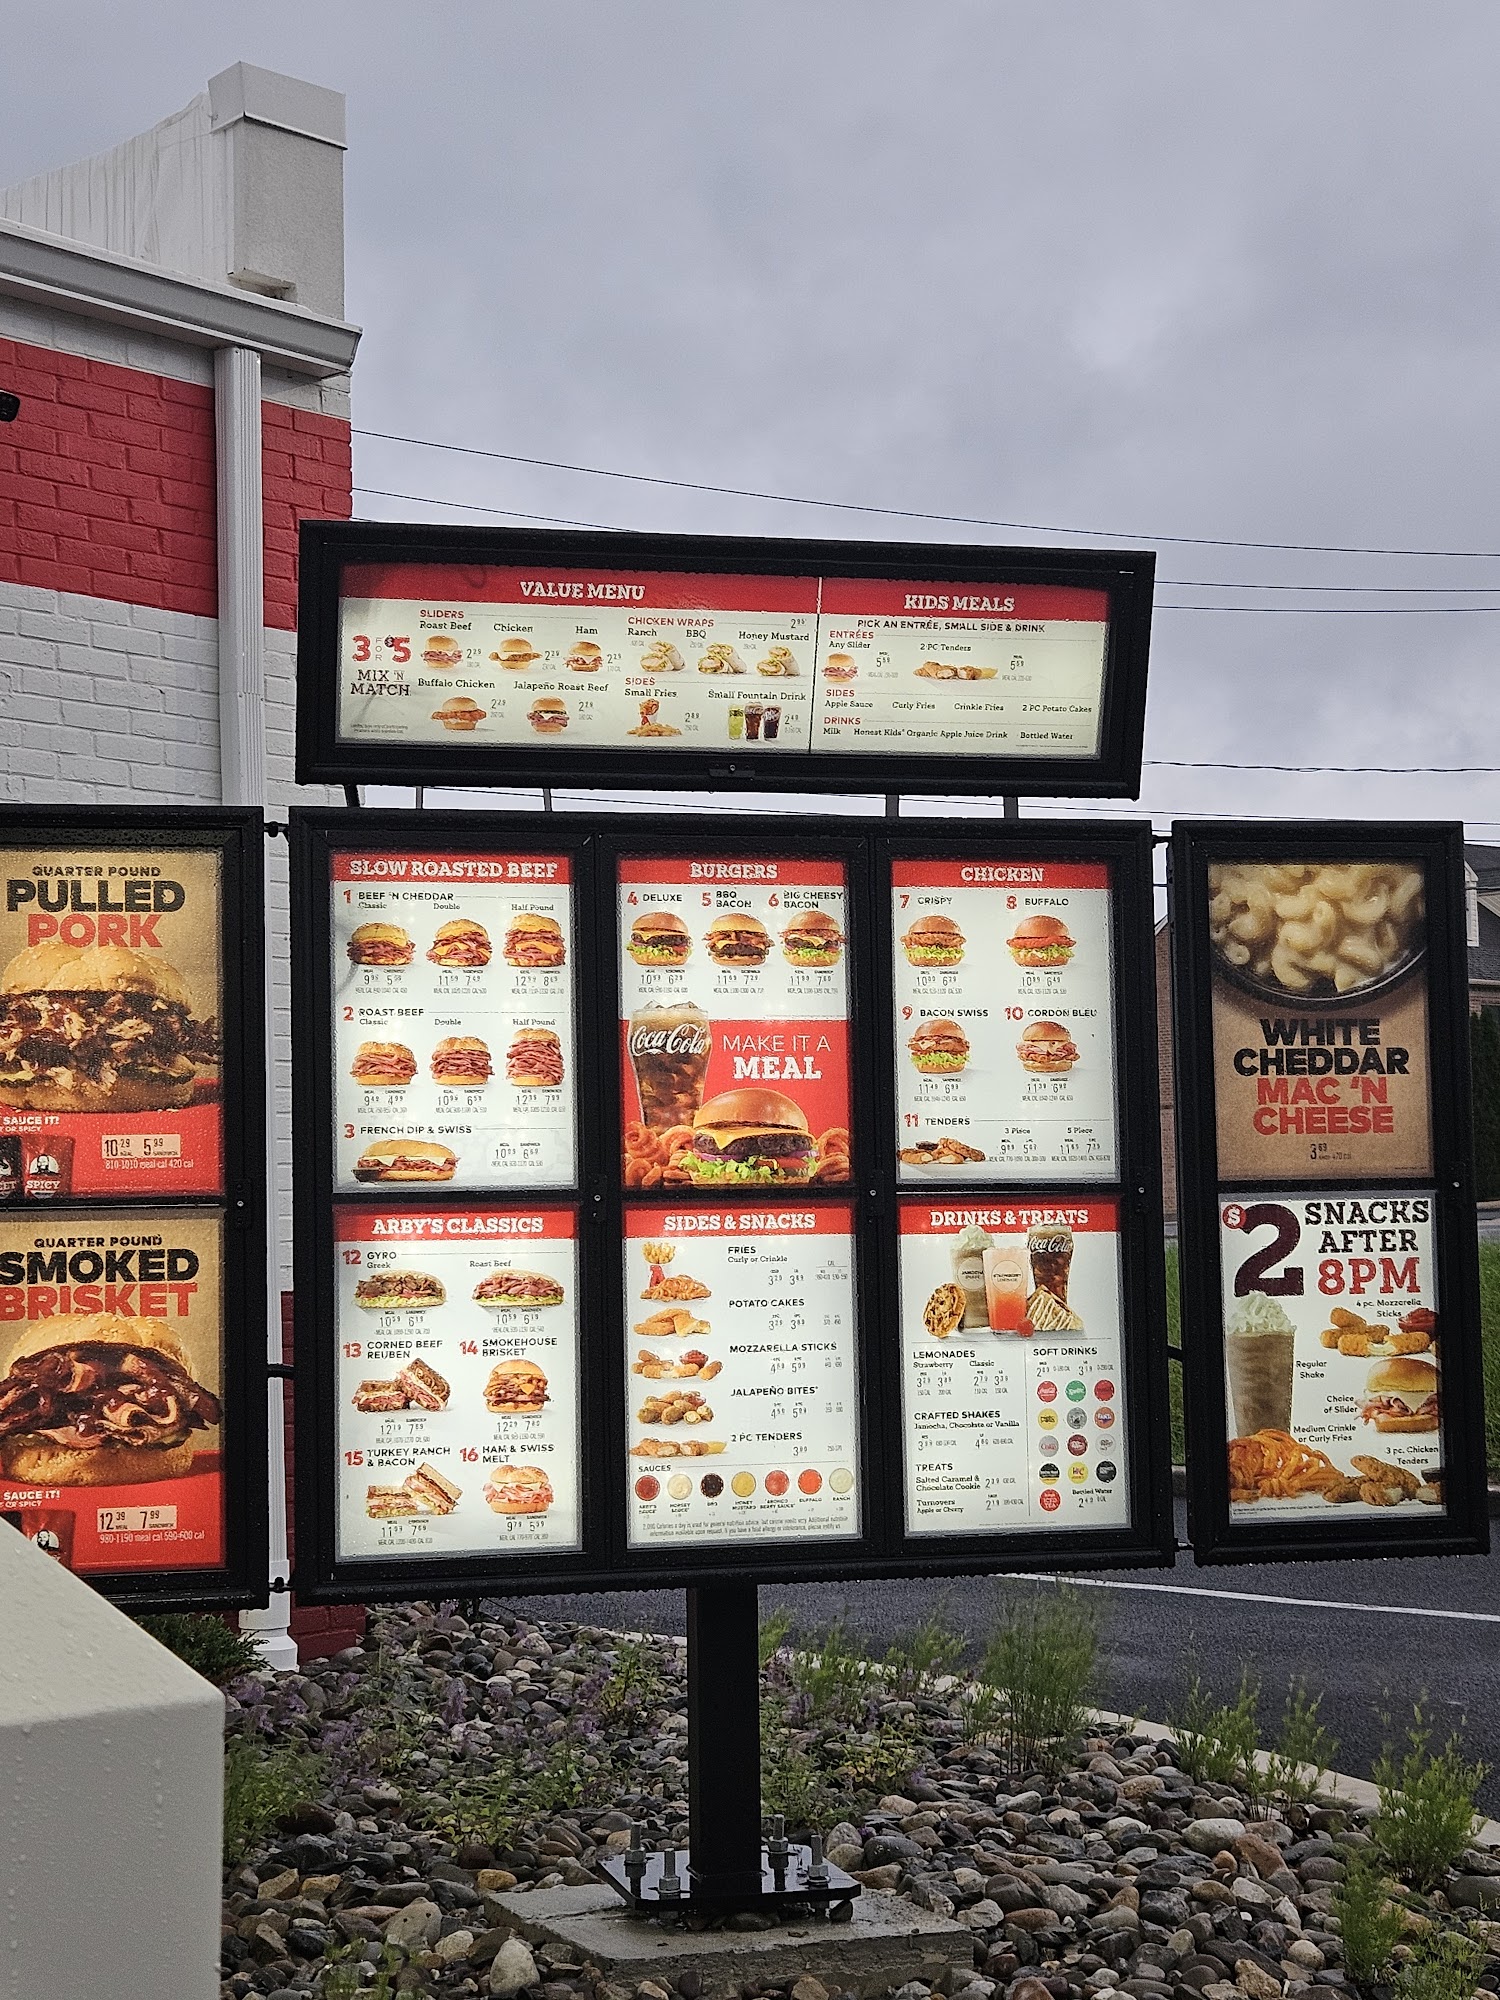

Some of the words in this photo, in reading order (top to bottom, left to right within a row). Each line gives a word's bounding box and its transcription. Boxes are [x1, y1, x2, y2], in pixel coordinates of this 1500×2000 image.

[520, 581, 584, 599] VALUE
[587, 584, 646, 600] MENU
[903, 595, 949, 610] KIDS
[952, 596, 1015, 612] MEALS
[420, 610, 464, 619] SLIDERS
[420, 621, 447, 630] Roast
[450, 622, 472, 631] Beef
[494, 624, 533, 633] Chicken
[628, 617, 674, 626] CHICKEN
[677, 619, 715, 627] WRAPS
[857, 620, 881, 628] PICK
[883, 621, 898, 629] AN
[945, 622, 978, 631] SMALL
[981, 623, 1003, 631] SIDE
[1005, 624, 1012, 632] &
[1015, 624, 1045, 632] DRINK
[575, 626, 598, 635] Ham
[628, 628, 657, 636] Ranch
[686, 629, 706, 638] BBQ
[739, 631, 768, 641] Honey
[771, 632, 809, 641] Mustard
[358, 669, 390, 681] MIX
[625, 677, 655, 685] SIDES
[350, 683, 411, 696] MATCH
[418, 678, 453, 688] Buffalo
[456, 679, 495, 688] Chicken
[513, 680, 555, 690] Jalapeño
[558, 683, 586, 691] Roast
[588, 683, 609, 692] Beef
[625, 689, 651, 697] Small
[654, 689, 677, 698] Fries
[826, 689, 855, 697] SIDES
[824, 717, 861, 725] DRINKS
[32, 866, 103, 877] QUARTER
[108, 866, 161, 876] POUND
[350, 861, 408, 875] SLOW
[411, 861, 502, 877] ROASTED
[507, 863, 558, 878] BEEF
[690, 863, 778, 879] BURGERS
[961, 867, 1045, 882] CHICKEN
[7, 879, 186, 912] PULLED
[343, 890, 352, 904] 1
[358, 892, 385, 900] BEEF
[627, 892, 639, 906] 4
[643, 894, 682, 902] DELUXE
[702, 892, 711, 907] 5
[768, 893, 779, 907] 6
[900, 895, 910, 909] 7
[918, 897, 952, 905] CRISPY
[716, 900, 752, 908] BACON
[784, 901, 819, 909] BACON
[1006, 896, 1017, 910] 8
[1025, 898, 1069, 906] BUFFALO
[28, 914, 163, 948] PORK
[343, 1007, 354, 1021] 2
[358, 1008, 394, 1017] ROAST
[902, 1006, 913, 1020] 9
[920, 1009, 954, 1017] BACON
[958, 1009, 989, 1017] SWISS
[1004, 1007, 1023, 1020] 10
[1028, 1009, 1070, 1017] CORDON
[1073, 1009, 1097, 1017] BLEU
[1260, 1018, 1380, 1046] WHITE
[631, 1023, 707, 1057] Coca-Cola
[723, 1035, 784, 1051] MAKE
[793, 1036, 810, 1051] IT
[817, 1036, 831, 1052] A
[733, 1055, 822, 1080] MEAL
[1233, 1047, 1410, 1076] CHEDDAR
[1257, 1076, 1340, 1105] MAC
[4, 1117, 42, 1125] SAUCE
[45, 1116, 59, 1124] IT!
[904, 1114, 919, 1128] 11
[1253, 1105, 1394, 1135] CHEESE
[344, 1124, 355, 1138] 3
[360, 1126, 404, 1134] FRENCH
[407, 1126, 425, 1134] DIP
[438, 1125, 472, 1134] SWISS
[26, 1180, 60, 1189] SPICY
[930, 1210, 1001, 1226] DRINKS
[1004, 1211, 1016, 1224] &
[1019, 1210, 1088, 1225] TREATS
[1305, 1200, 1429, 1226] SNACKS
[372, 1217, 444, 1235] ARBY'S
[447, 1217, 544, 1234] CLASSICS
[664, 1215, 721, 1232] SIDES
[724, 1216, 736, 1230] &
[739, 1214, 815, 1230] SNACKS
[34, 1237, 105, 1248] QUARTER
[110, 1235, 162, 1246] POUND
[1318, 1229, 1419, 1253] AFTER
[728, 1246, 756, 1254] FRIES
[1222, 1203, 1304, 1297] $2
[343, 1249, 361, 1265] 12
[367, 1252, 396, 1260] GYRO
[0, 1249, 199, 1285] SMOKED
[1318, 1257, 1421, 1296] 8PM
[0, 1283, 198, 1321] BRISKET
[729, 1300, 768, 1308] POTATO
[770, 1299, 804, 1307] CAKES
[343, 1343, 361, 1358] 13
[367, 1341, 412, 1349] CORNED
[416, 1340, 443, 1348] BEEF
[460, 1341, 478, 1356] 14
[482, 1337, 557, 1347] SMOKEHOUSE
[482, 1348, 526, 1357] BRISKET
[730, 1344, 797, 1353] MOZZARELLA
[801, 1342, 837, 1351] STICKS
[1033, 1348, 1058, 1356] SOFT
[1061, 1347, 1097, 1355] DRINKS
[367, 1350, 410, 1359] REUBEN
[913, 1350, 976, 1359] LEMONADES
[913, 1361, 953, 1369] Strawberry
[1296, 1361, 1327, 1369] Regular
[1300, 1371, 1324, 1379] Shake
[914, 1412, 959, 1420] CRAFTED
[962, 1411, 1000, 1419] SHAKES
[1293, 1425, 1326, 1433] Medium
[1328, 1424, 1356, 1432] Crinkle
[345, 1451, 364, 1466] 15
[367, 1448, 409, 1457] TURKEY
[413, 1447, 450, 1456] RANCH
[460, 1447, 478, 1462] 16
[483, 1445, 506, 1453] HAM
[520, 1444, 554, 1452] SWISS
[483, 1455, 509, 1463] MELT
[367, 1459, 374, 1467] &
[378, 1458, 415, 1466] BACON
[916, 1463, 953, 1472] TREATS
[4, 1492, 42, 1500] SAUCE
[46, 1490, 60, 1499] IT!
